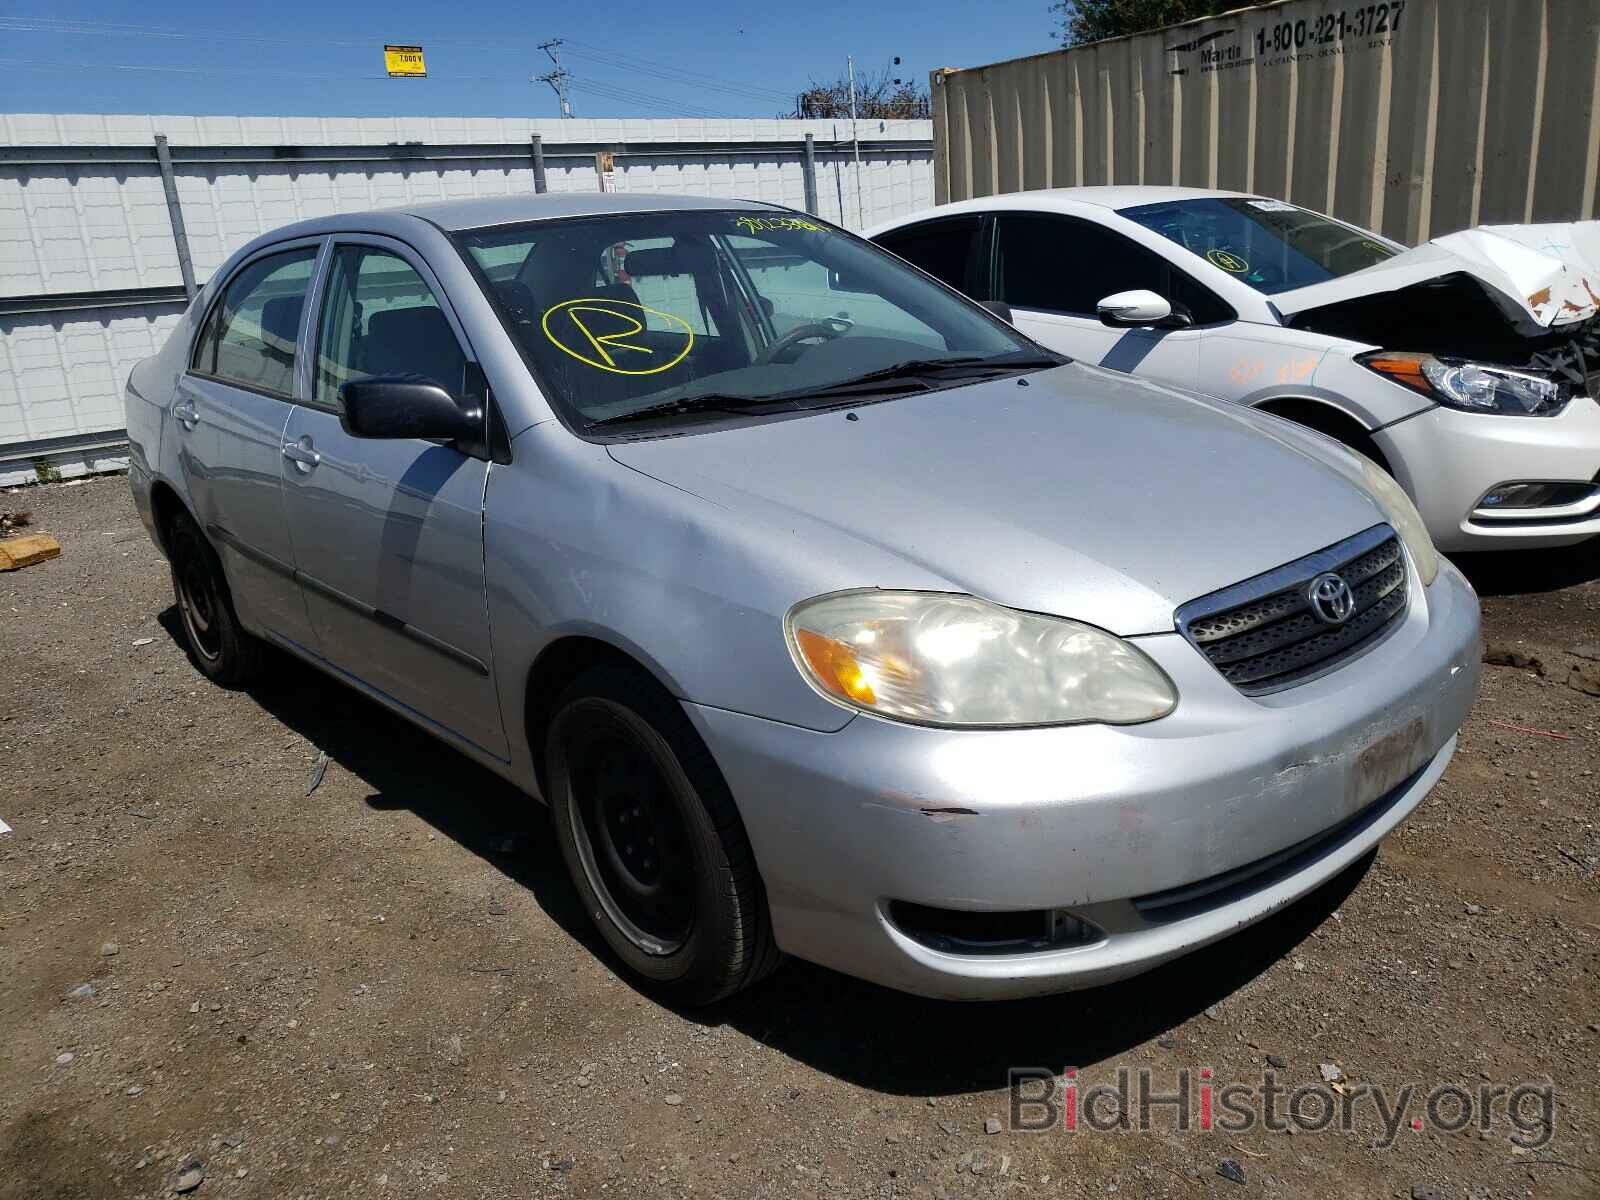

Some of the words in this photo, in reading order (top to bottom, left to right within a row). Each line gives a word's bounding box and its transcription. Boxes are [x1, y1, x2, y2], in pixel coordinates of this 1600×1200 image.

[1200, 45, 1241, 65] Martin
[1256, 1, 1405, 55] 1-800-221-3727
[567, 307, 654, 367] R
